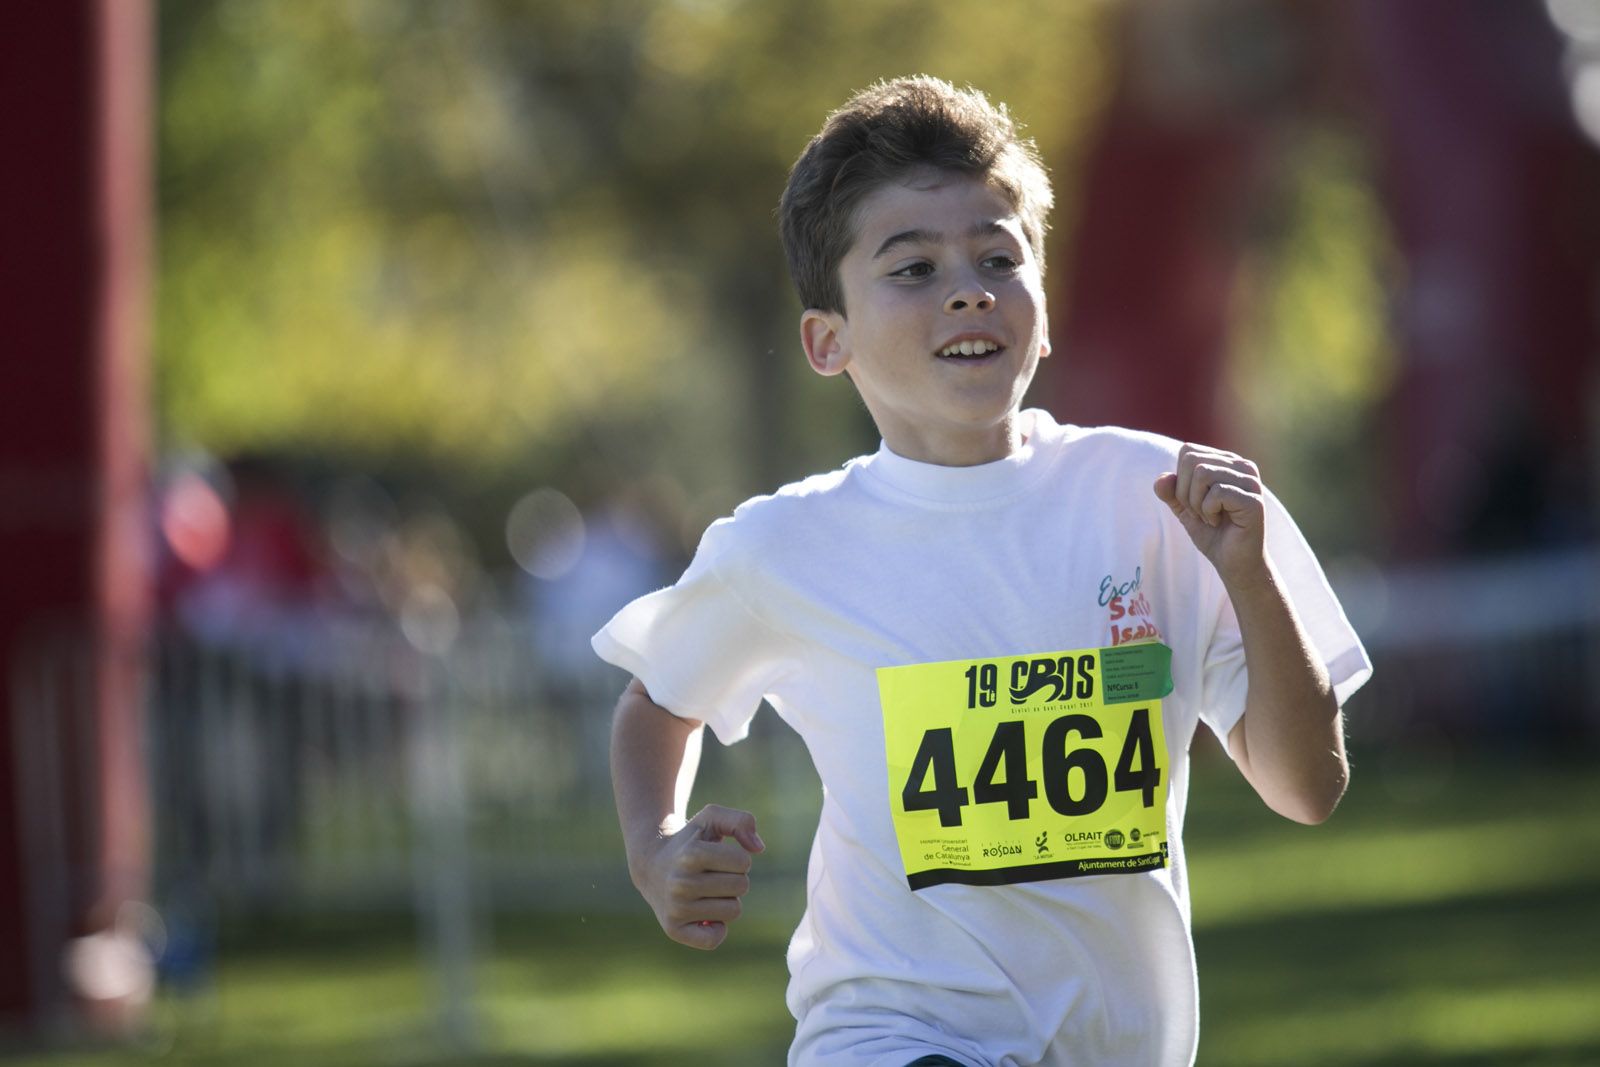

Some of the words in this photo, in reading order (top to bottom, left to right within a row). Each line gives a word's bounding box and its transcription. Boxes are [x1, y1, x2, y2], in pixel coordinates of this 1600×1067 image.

[1009, 655, 1095, 704] CROS
[902, 708, 1161, 827] 4464
[1064, 831, 1103, 843] OLRAIT
[941, 845, 969, 853] General
[983, 845, 1022, 857] ROSDAN
[924, 853, 934, 861] de
[935, 852, 971, 862] Catalunya
[1078, 860, 1126, 872] Ajuntament
[1127, 858, 1137, 868] de
